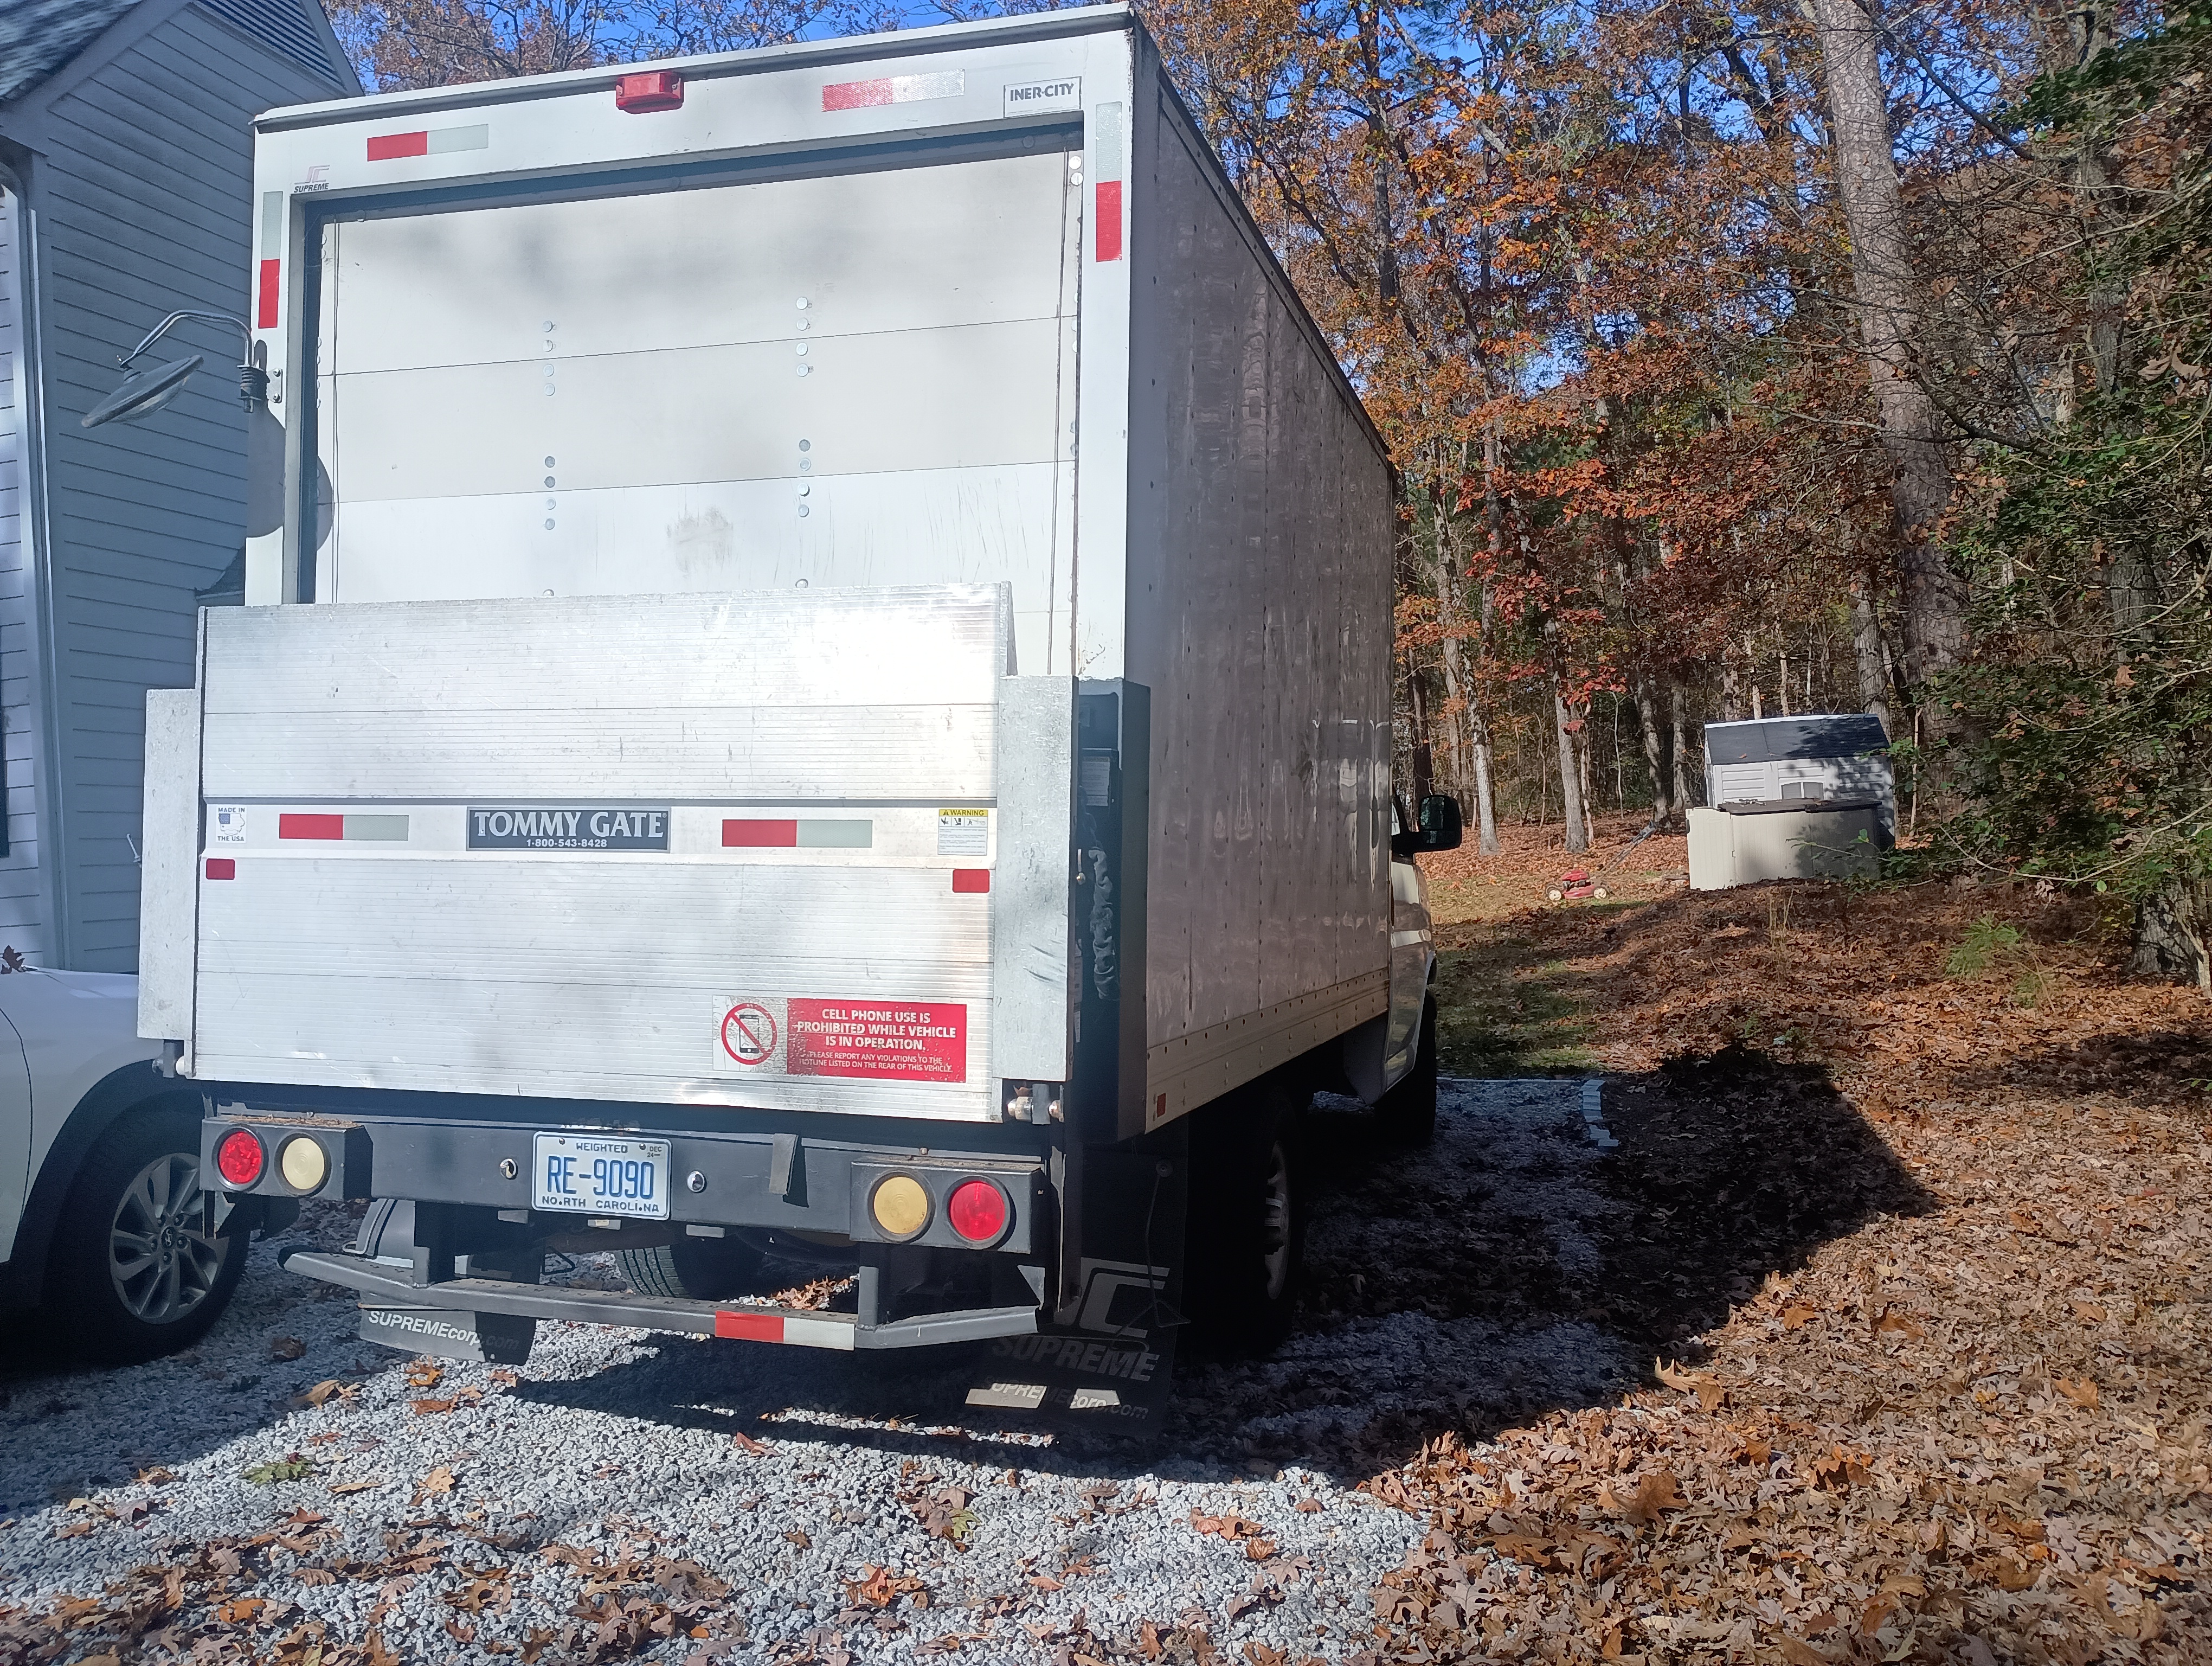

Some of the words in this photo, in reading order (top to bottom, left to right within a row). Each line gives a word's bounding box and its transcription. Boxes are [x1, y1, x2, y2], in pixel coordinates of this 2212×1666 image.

[294, 183, 329, 193] SUPREME
[474, 812, 581, 837] TOMMY
[526, 839, 607, 848] 1-800-543-8428
[822, 1009, 848, 1020] CELL
[851, 1010, 892, 1022] PHONE
[895, 1011, 917, 1023] USE
[919, 1013, 930, 1023] IS
[798, 1021, 865, 1034] PROHIBITED
[868, 1023, 905, 1036] WHILE
[908, 1026, 956, 1038] VEHICLE
[826, 1036, 837, 1046] IS
[839, 1036, 852, 1047] IN
[877, 1054, 917, 1063] VIOLATIONS
[576, 1142, 628, 1154] WEIGHTED
[548, 1156, 654, 1200] RE-9090
[542, 1196, 586, 1207] NORTH
[596, 1200, 659, 1213] CAROLINA
[992, 1335, 1160, 1382] SUPREME
